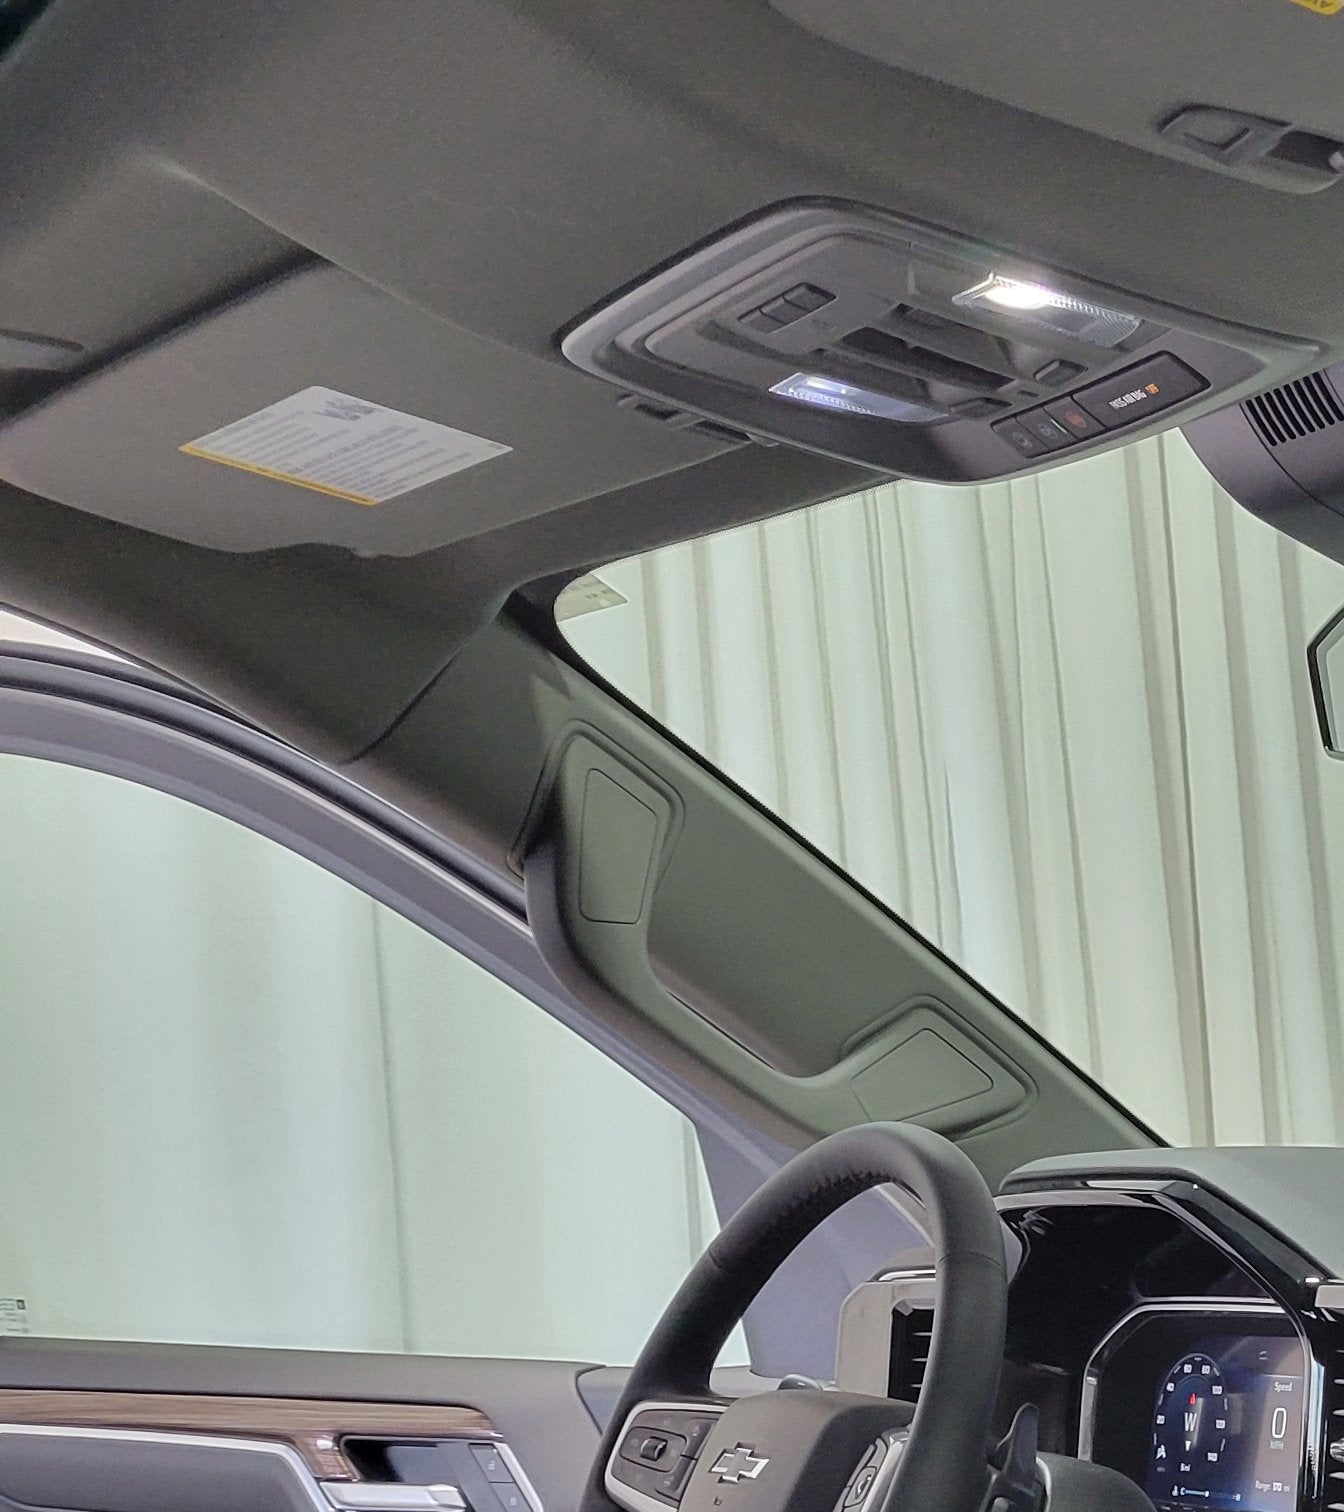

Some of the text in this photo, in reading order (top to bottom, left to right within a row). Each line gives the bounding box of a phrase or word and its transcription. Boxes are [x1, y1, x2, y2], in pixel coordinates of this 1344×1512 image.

[1129, 389, 1148, 401] BAG
[1274, 1381, 1293, 1393] Speed
[1184, 1412, 1197, 1432] W
[1271, 1407, 1287, 1438] 0
